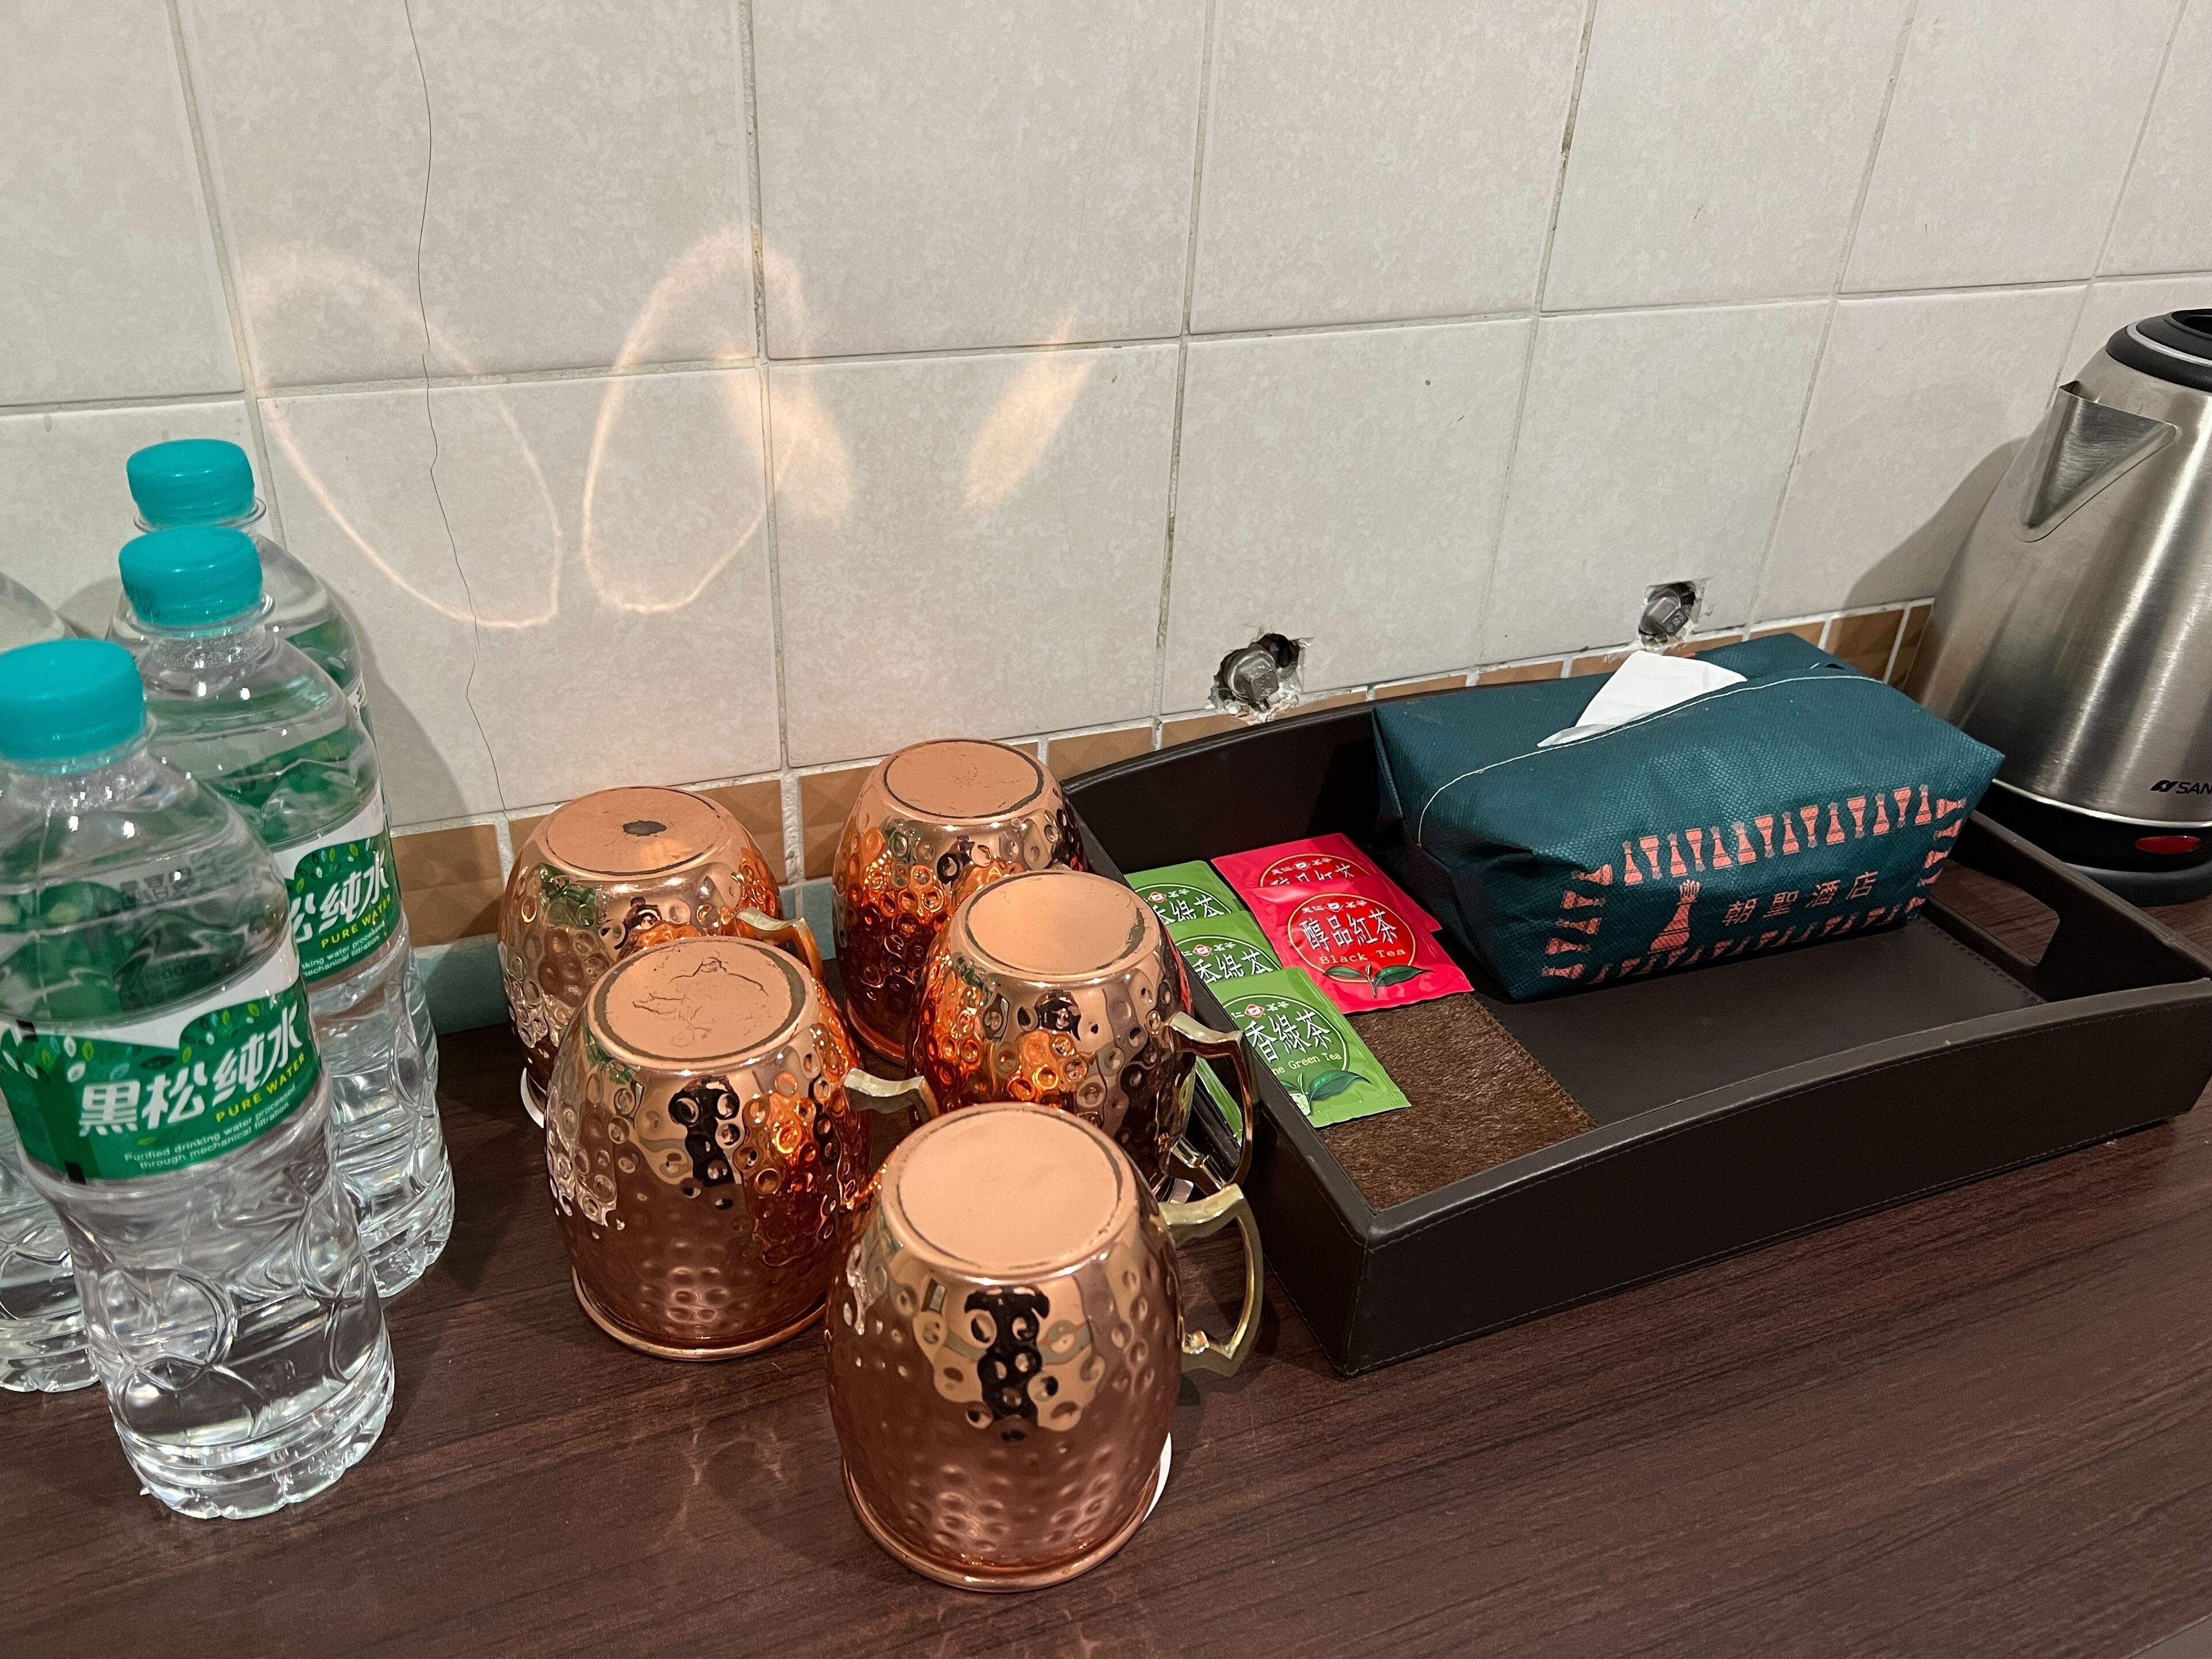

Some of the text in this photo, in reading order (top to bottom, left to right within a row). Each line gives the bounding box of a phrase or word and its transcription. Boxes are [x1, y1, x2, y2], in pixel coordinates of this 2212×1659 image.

[1722, 871, 1878, 926] 朝聖酒店
[321, 894, 391, 948] PURE WATER
[1299, 908, 1398, 952] 醇品紅茶
[327, 945, 350, 960] water
[1319, 949, 1406, 965] Black Tea
[1288, 1055, 1320, 1070] Green
[1321, 1052, 1342, 1061] Tea
[216, 1052, 305, 1123] PURE WATER
[124, 1084, 296, 1162] Purified drinking water processed
[140, 1154, 186, 1169] through
[190, 1127, 252, 1158] mechanical
